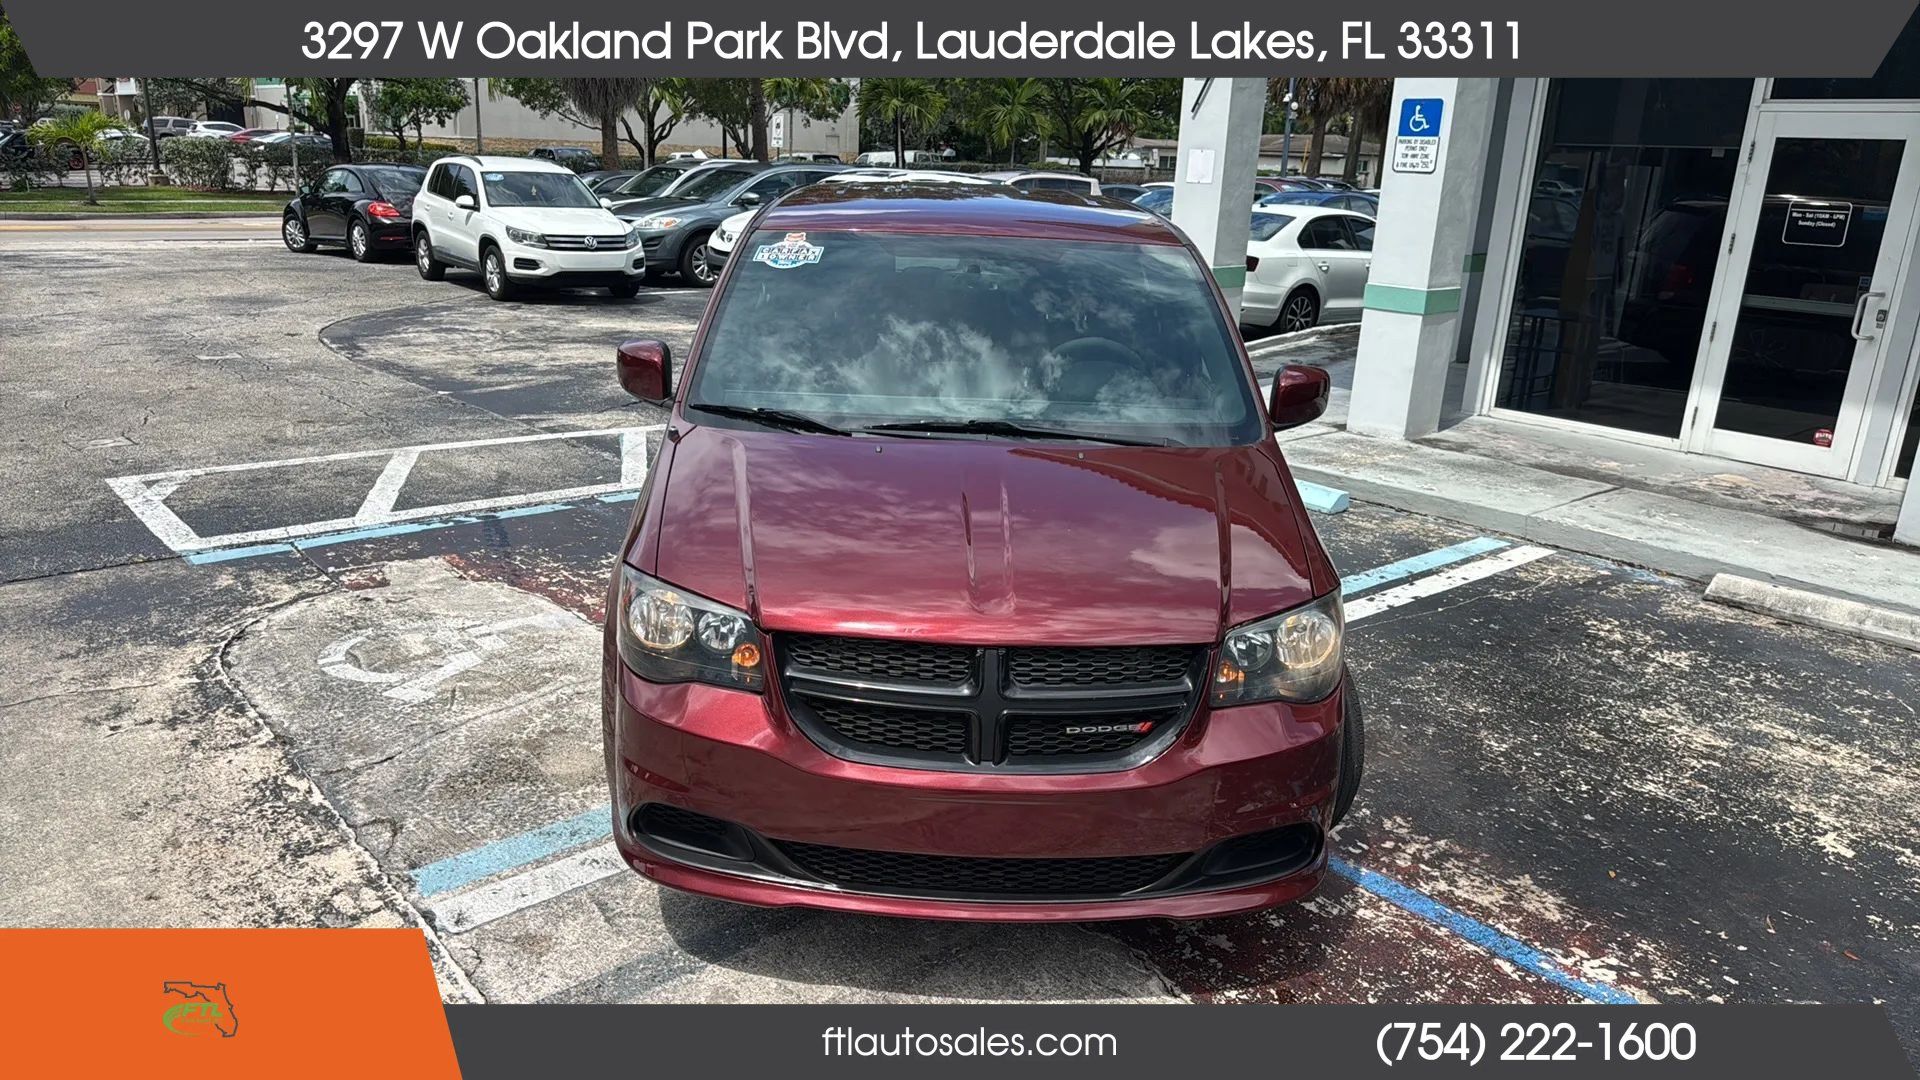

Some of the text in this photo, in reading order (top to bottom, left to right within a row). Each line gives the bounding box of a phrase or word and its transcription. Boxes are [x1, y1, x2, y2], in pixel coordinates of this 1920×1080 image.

[762, 247, 820, 255] CARFAX
[769, 253, 816, 261] OWNER
[1065, 724, 1139, 734] DODGE
